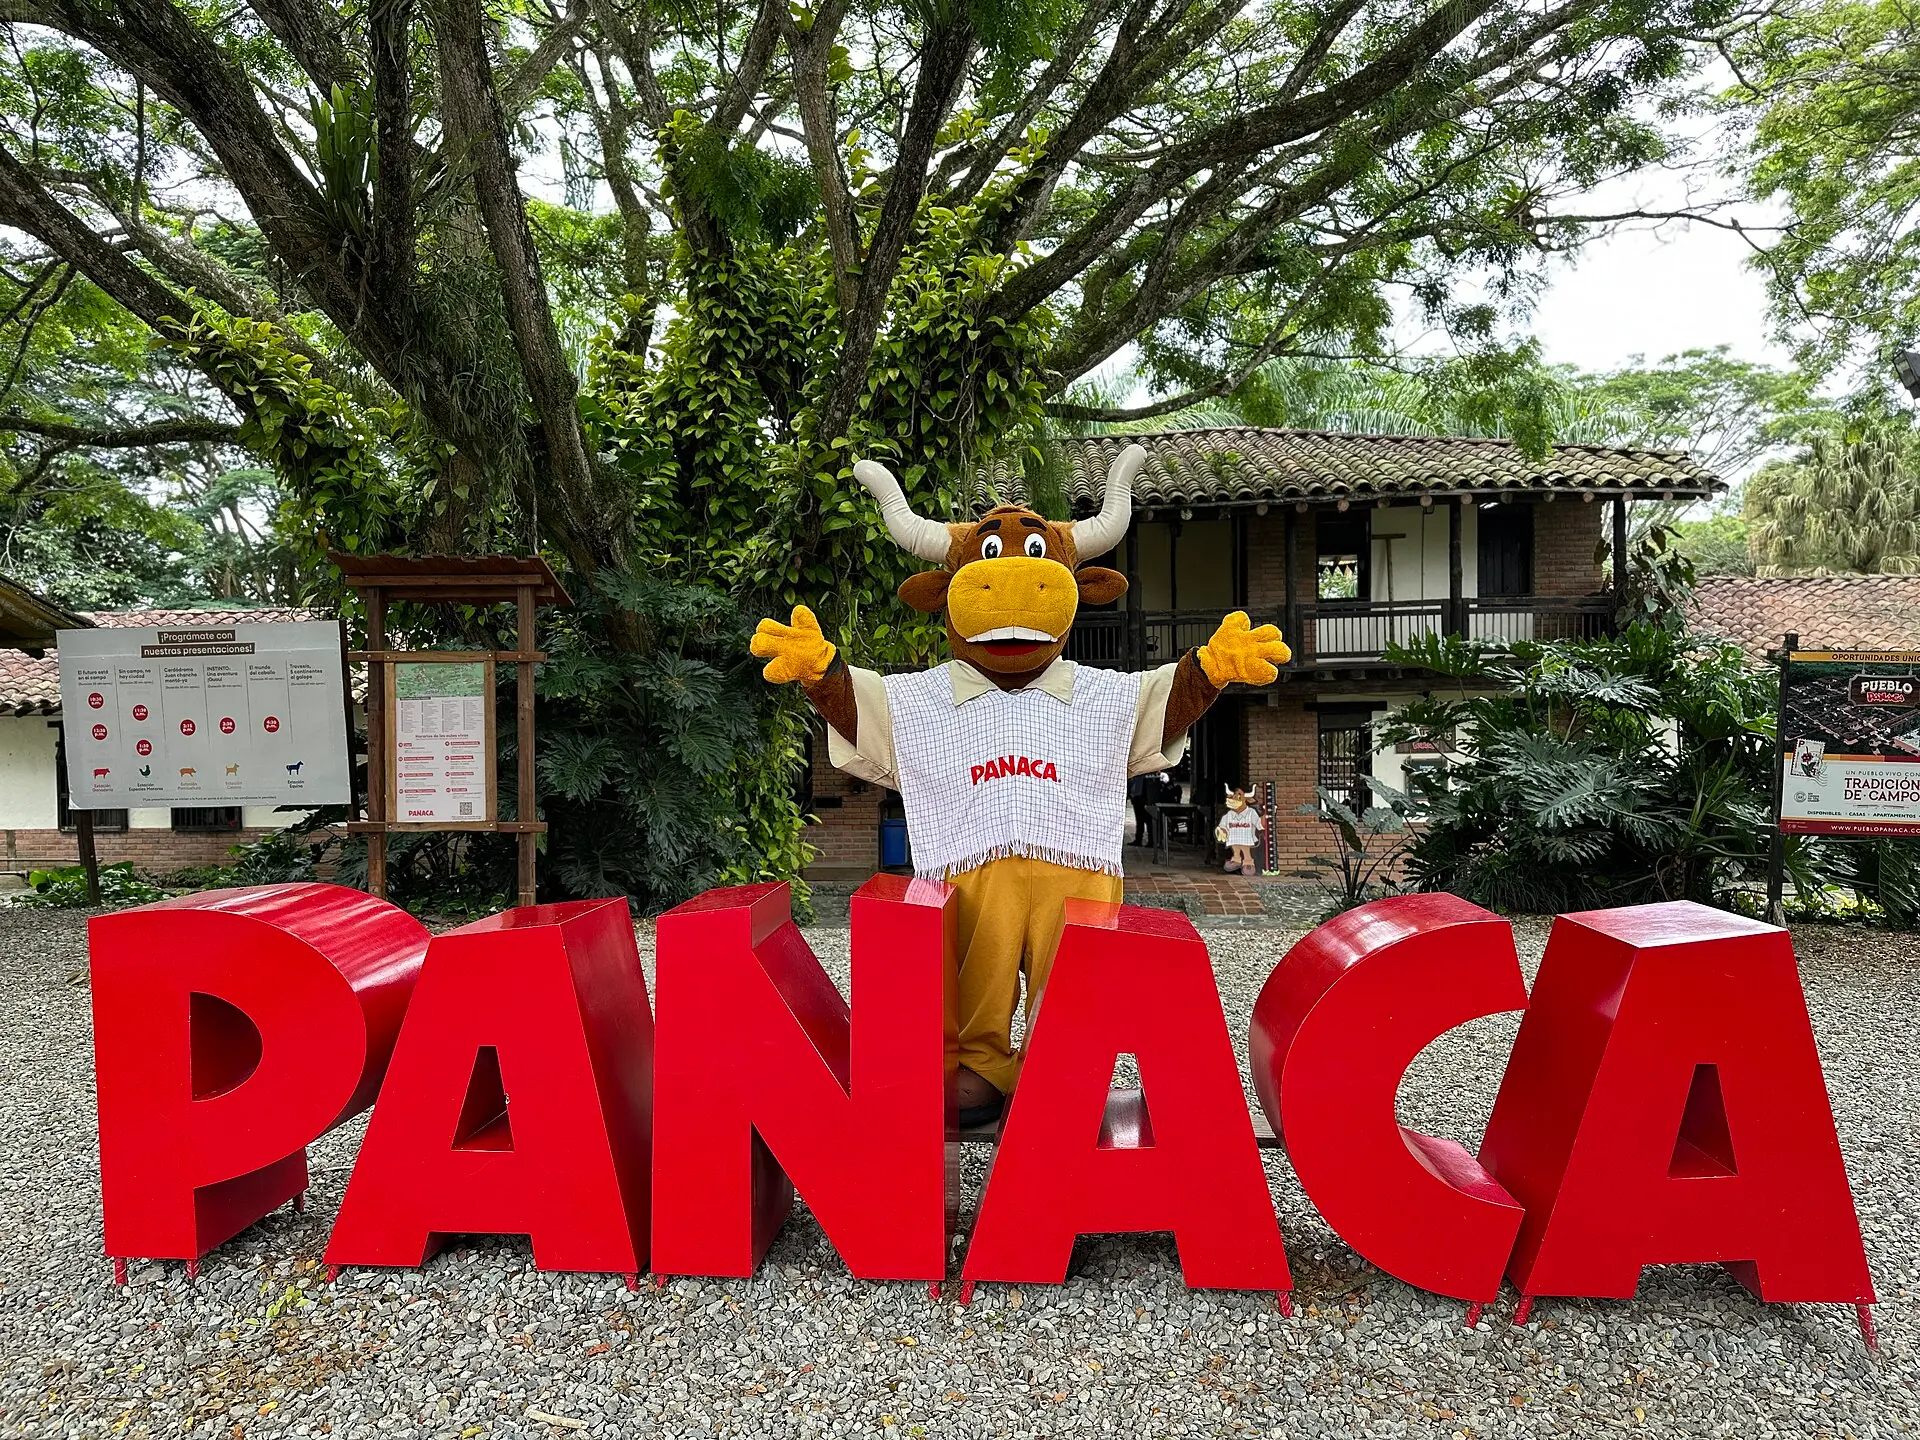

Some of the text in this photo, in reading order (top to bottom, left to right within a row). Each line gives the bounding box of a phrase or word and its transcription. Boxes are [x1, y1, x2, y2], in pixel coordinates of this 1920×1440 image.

[160, 632, 214, 642] ¡Prográmate
[143, 644, 253, 656] nuestras presentaciones!
[1832, 653, 1900, 662] OPORTUNIDADES
[1861, 681, 1913, 695] PUEBLO
[1844, 776, 1920, 790] TRADICIÓN
[1844, 789, 1920, 802] DE CAMPO
[89, 872, 1877, 1306] PANACA
